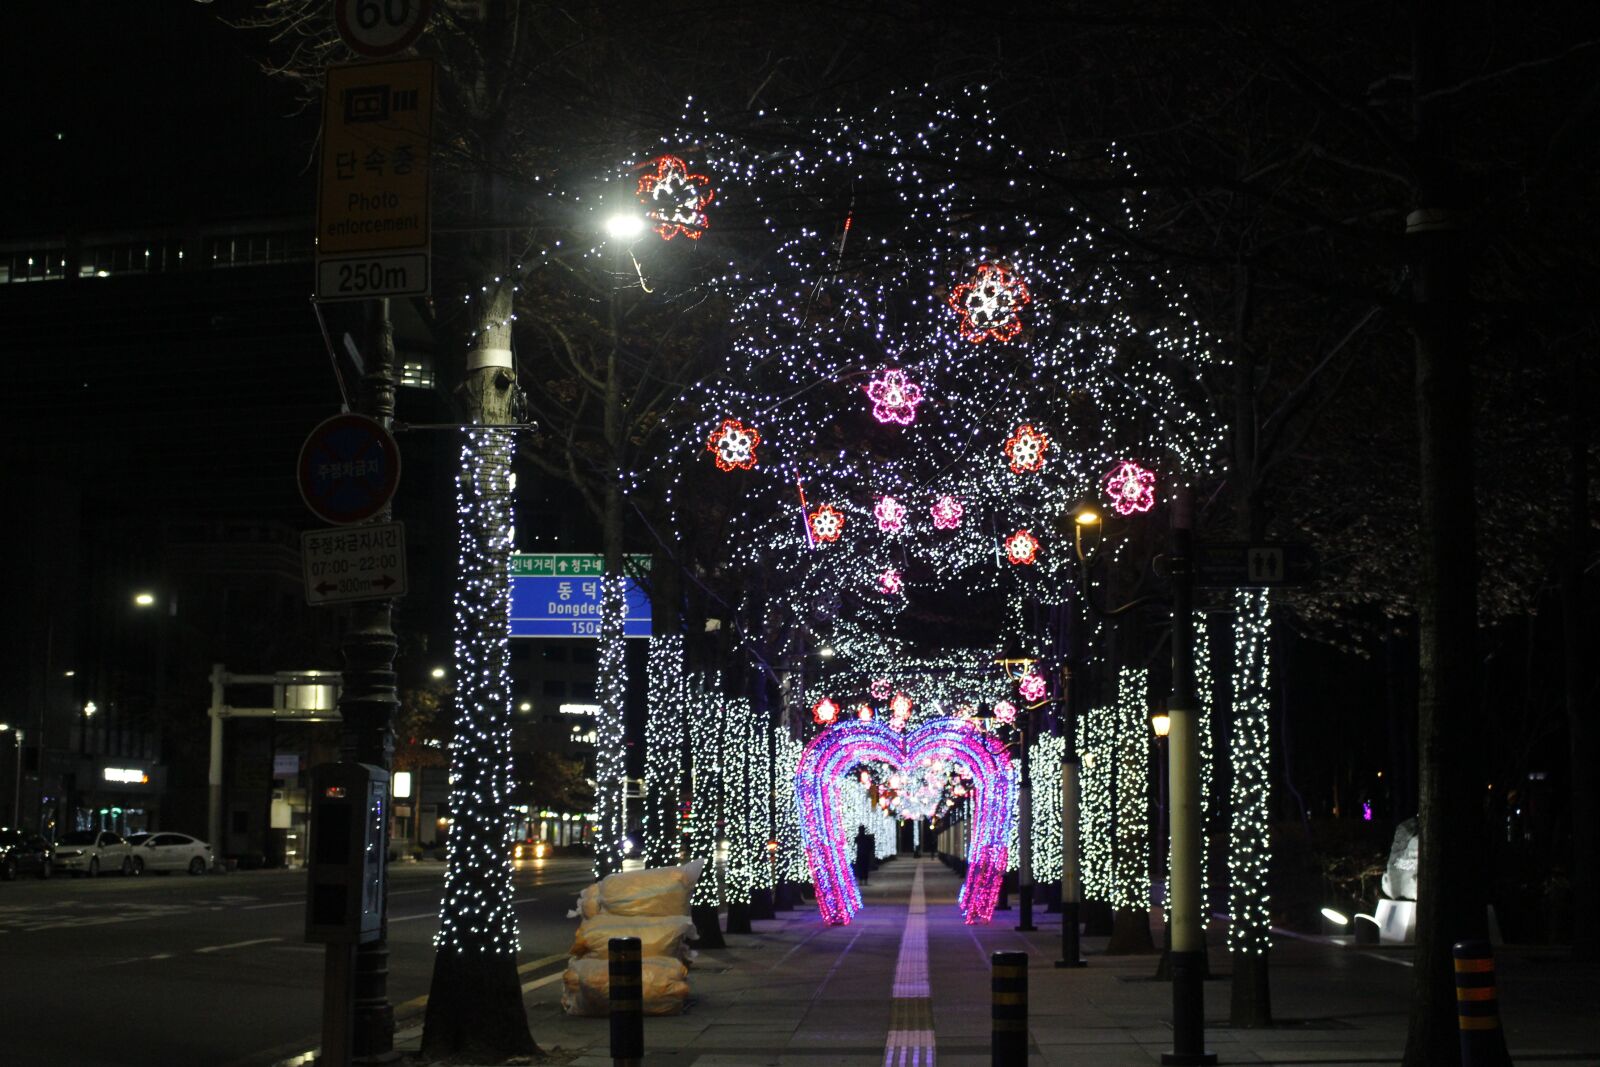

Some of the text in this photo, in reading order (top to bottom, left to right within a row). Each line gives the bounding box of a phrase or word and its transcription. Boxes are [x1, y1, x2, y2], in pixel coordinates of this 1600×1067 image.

[356, 0, 409, 30] 60
[336, 144, 416, 181] 단속중
[348, 190, 400, 213] Photo
[327, 214, 419, 236] enforcement
[338, 262, 408, 292] 250m
[317, 458, 379, 481] 주정차금지
[308, 529, 397, 556] 주정차금지시간
[512, 558, 554, 573] 인네거리
[571, 558, 603, 573] 청구네
[338, 578, 371, 593] 300m
[557, 581, 597, 600] 동덕
